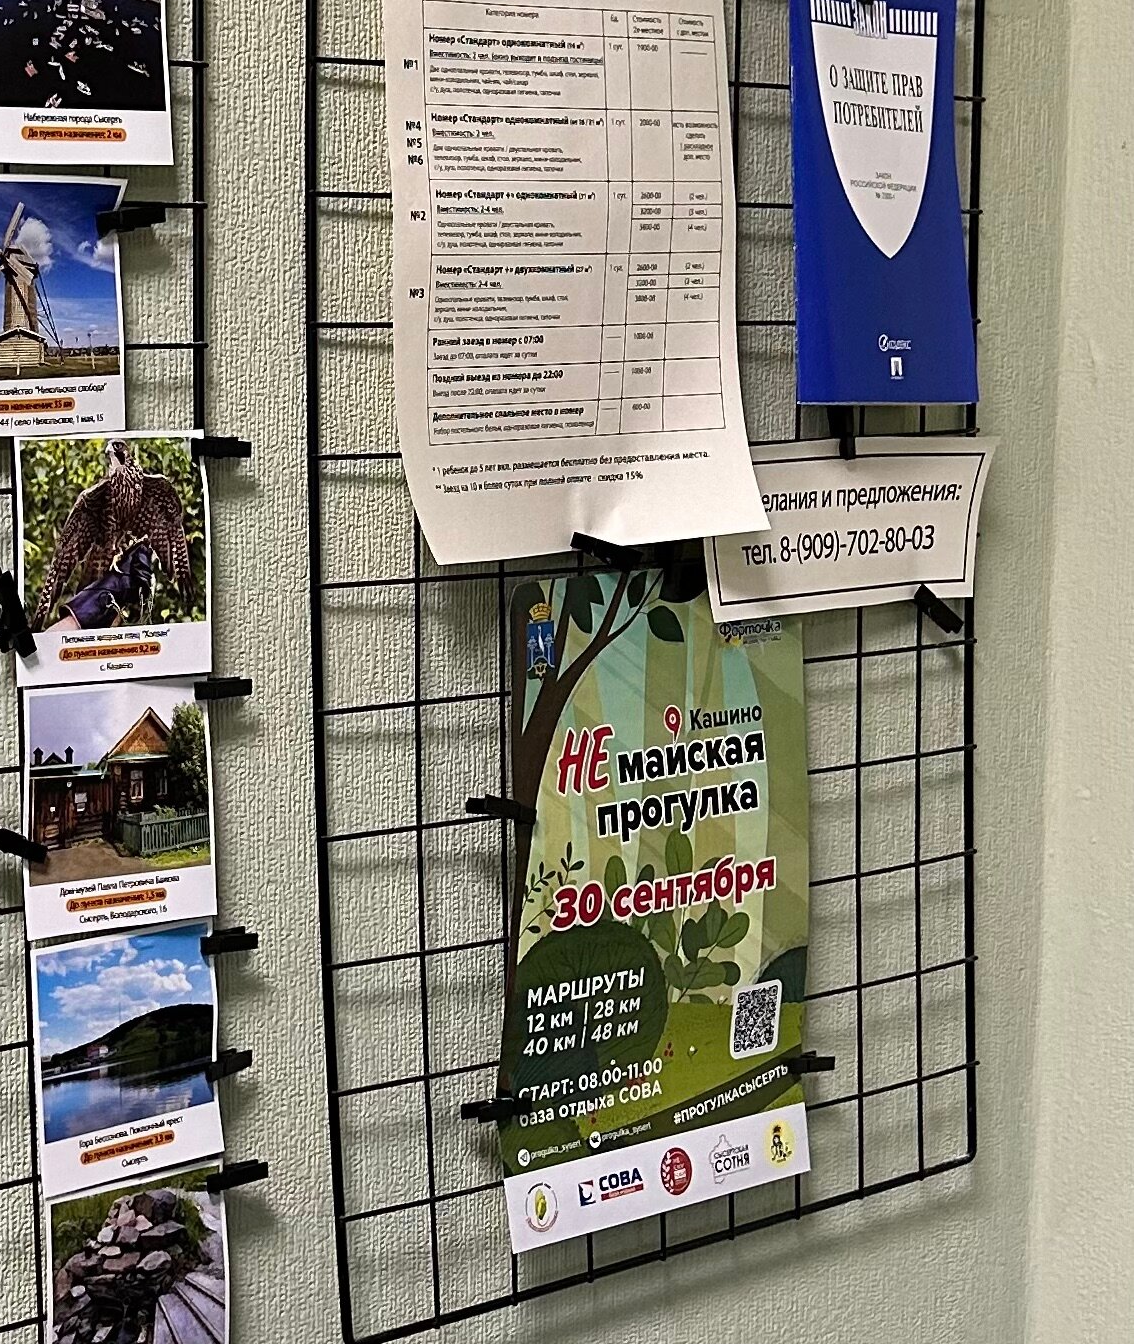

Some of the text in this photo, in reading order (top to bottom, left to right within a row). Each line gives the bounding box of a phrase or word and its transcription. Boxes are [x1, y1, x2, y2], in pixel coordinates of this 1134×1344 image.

[829, 64, 923, 98] О ЗАЩИТЕ ПРАВ
[833, 101, 923, 133] ПОТРЕБИТЕЛЕЙ
[822, 484, 962, 512] и предложения:
[742, 524, 934, 566] тел. 8-(909)-702-80-03
[690, 705, 762, 731] Кашино
[558, 726, 614, 796] НЕ
[598, 778, 758, 842] прогулка
[551, 855, 776, 931] 30 сентября
[527, 967, 645, 1008] МАРШРУТЫ
[526, 996, 641, 1033] 12 км 28 км
[523, 1018, 639, 1057] 40 км 48 км
[518, 1058, 662, 1102] СТАРТ: 08.00-11.00
[558, 1094, 614, 1118] отдыха
[619, 1080, 662, 1104] СОВА
[673, 1064, 788, 1125] #ПРОГУЛКАСЫСЕРТЬ
[599, 1168, 643, 1192] СОВА
[715, 1152, 750, 1173] СОТНЯ
